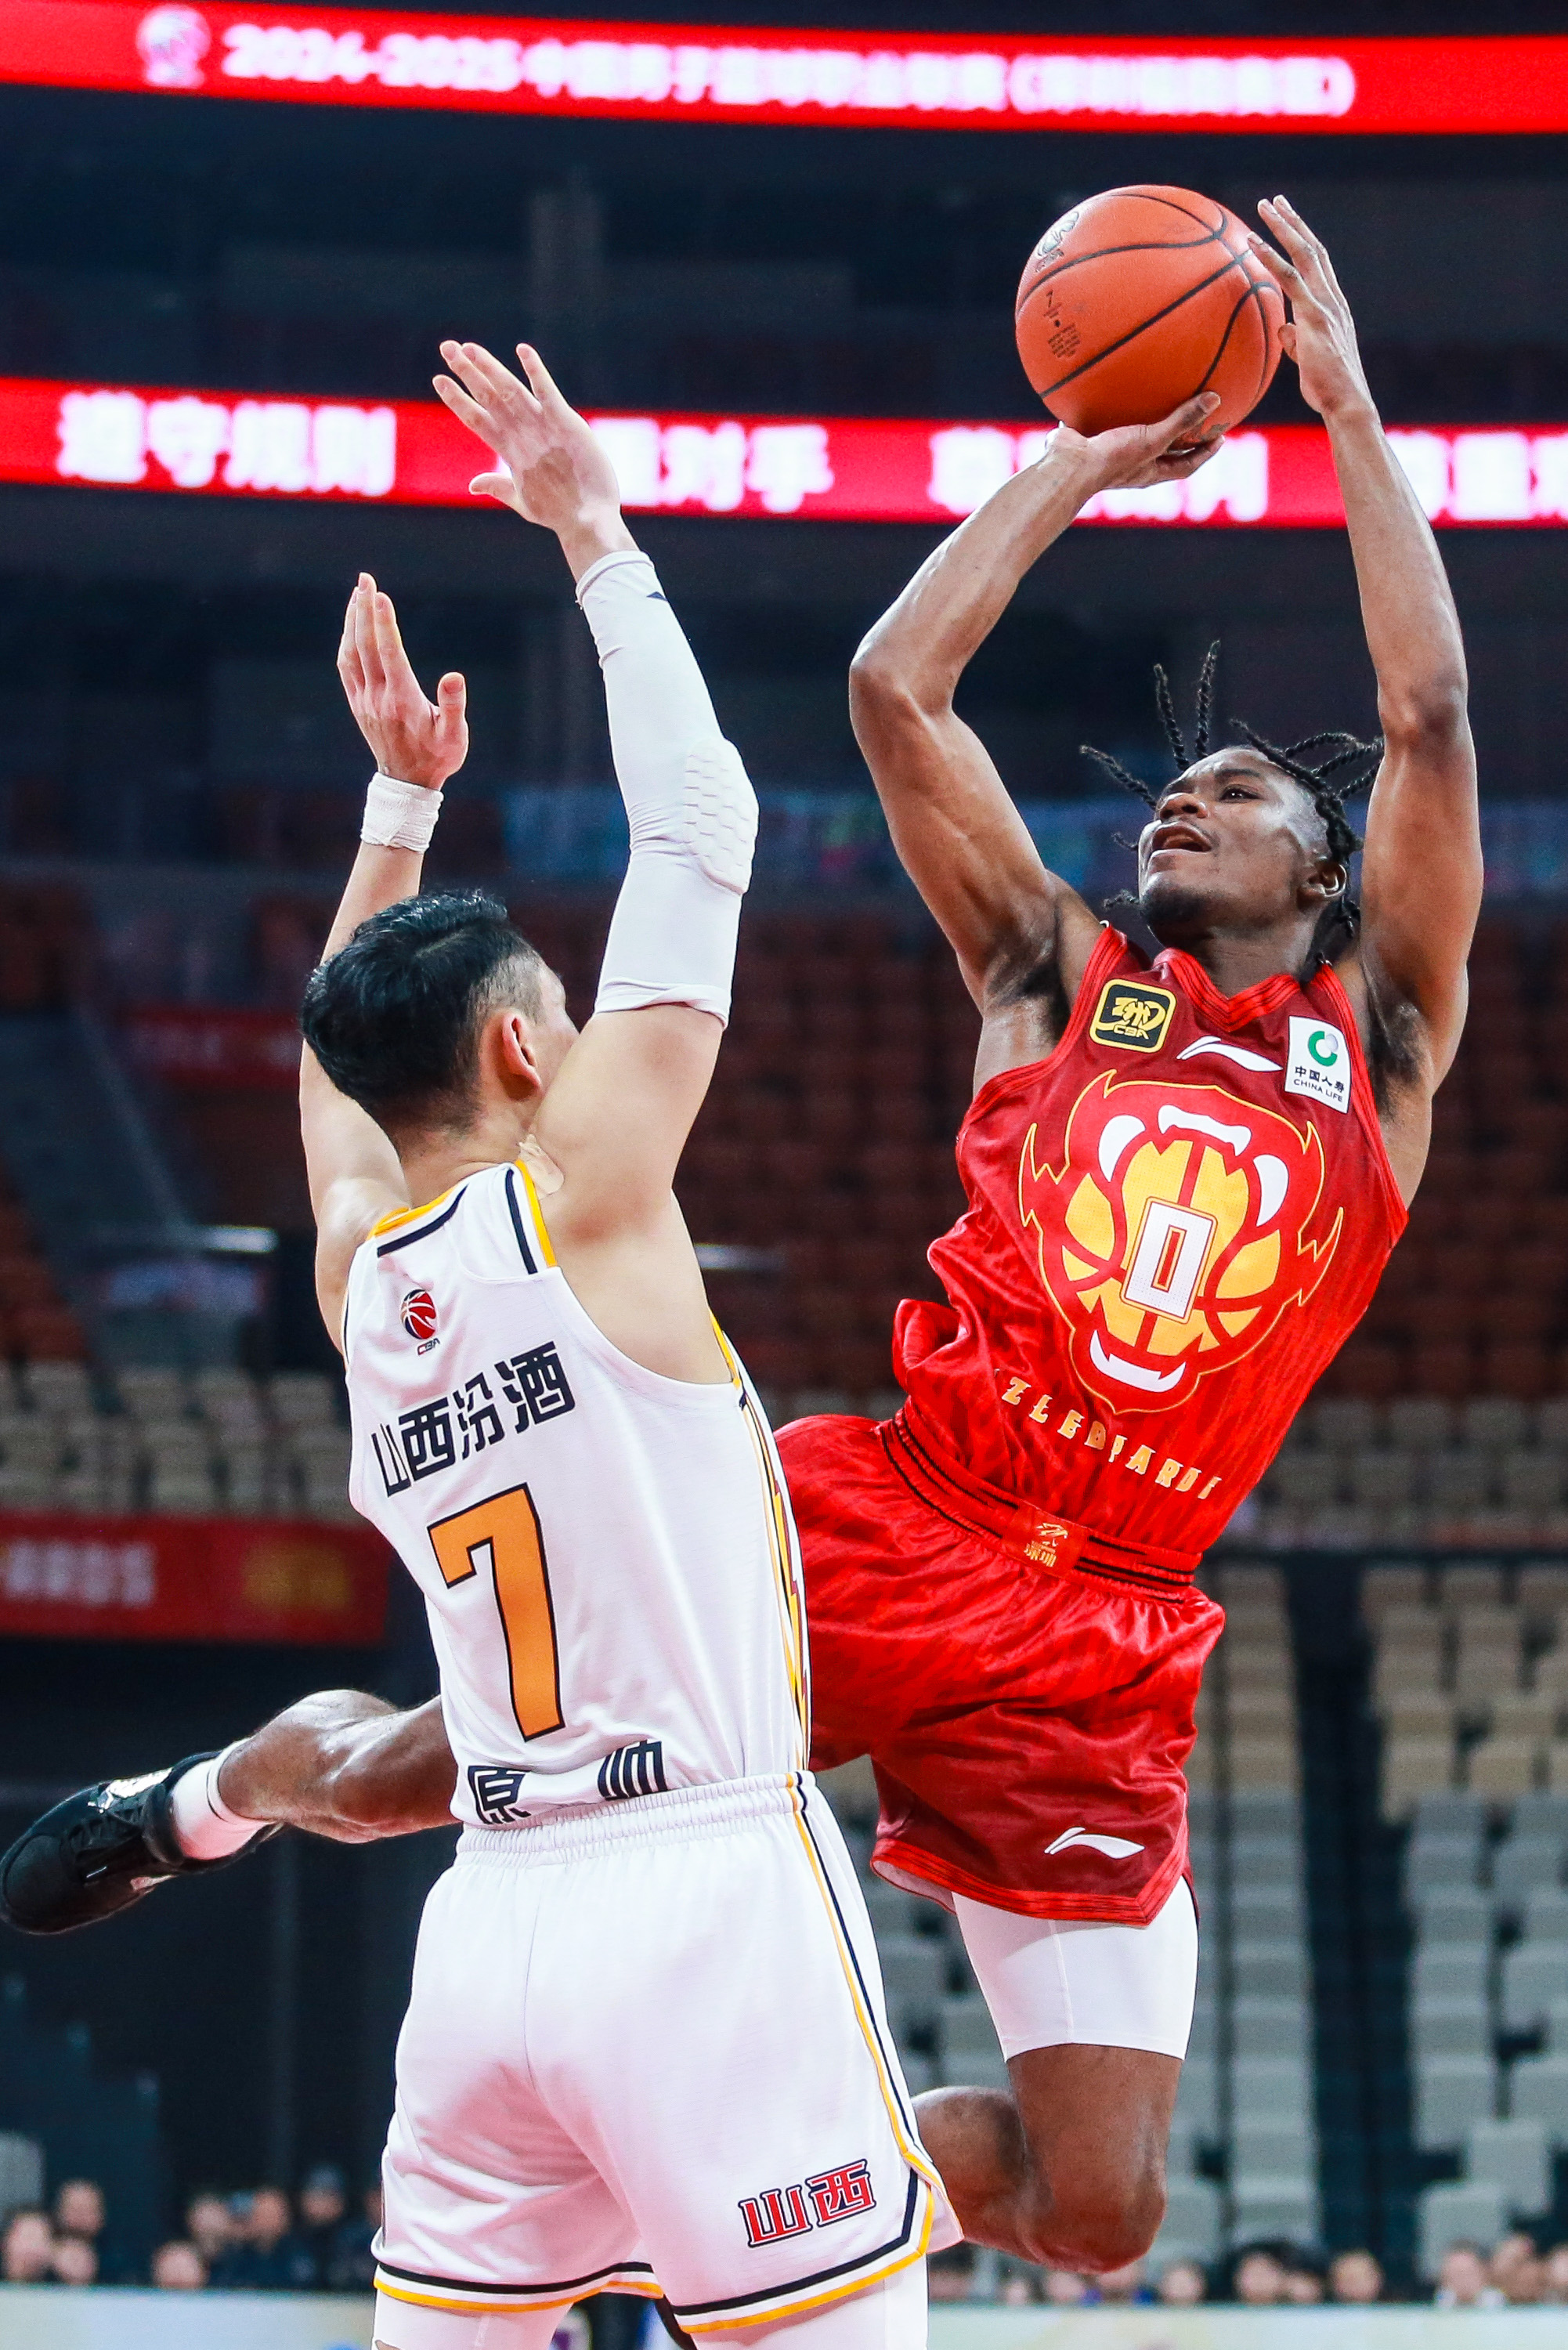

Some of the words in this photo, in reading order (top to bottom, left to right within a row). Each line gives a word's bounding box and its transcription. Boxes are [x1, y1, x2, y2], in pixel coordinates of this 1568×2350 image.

[1113, 1024, 1150, 1040] CBA
[1294, 1079, 1323, 1093] CHINA
[1326, 1090, 1342, 1102] LIFE
[1295, 1066, 1345, 1093] 中国人寿
[372, 1341, 576, 1497] 山西汾酒
[427, 1482, 566, 1743] 7
[738, 2158, 877, 2248] 山西
